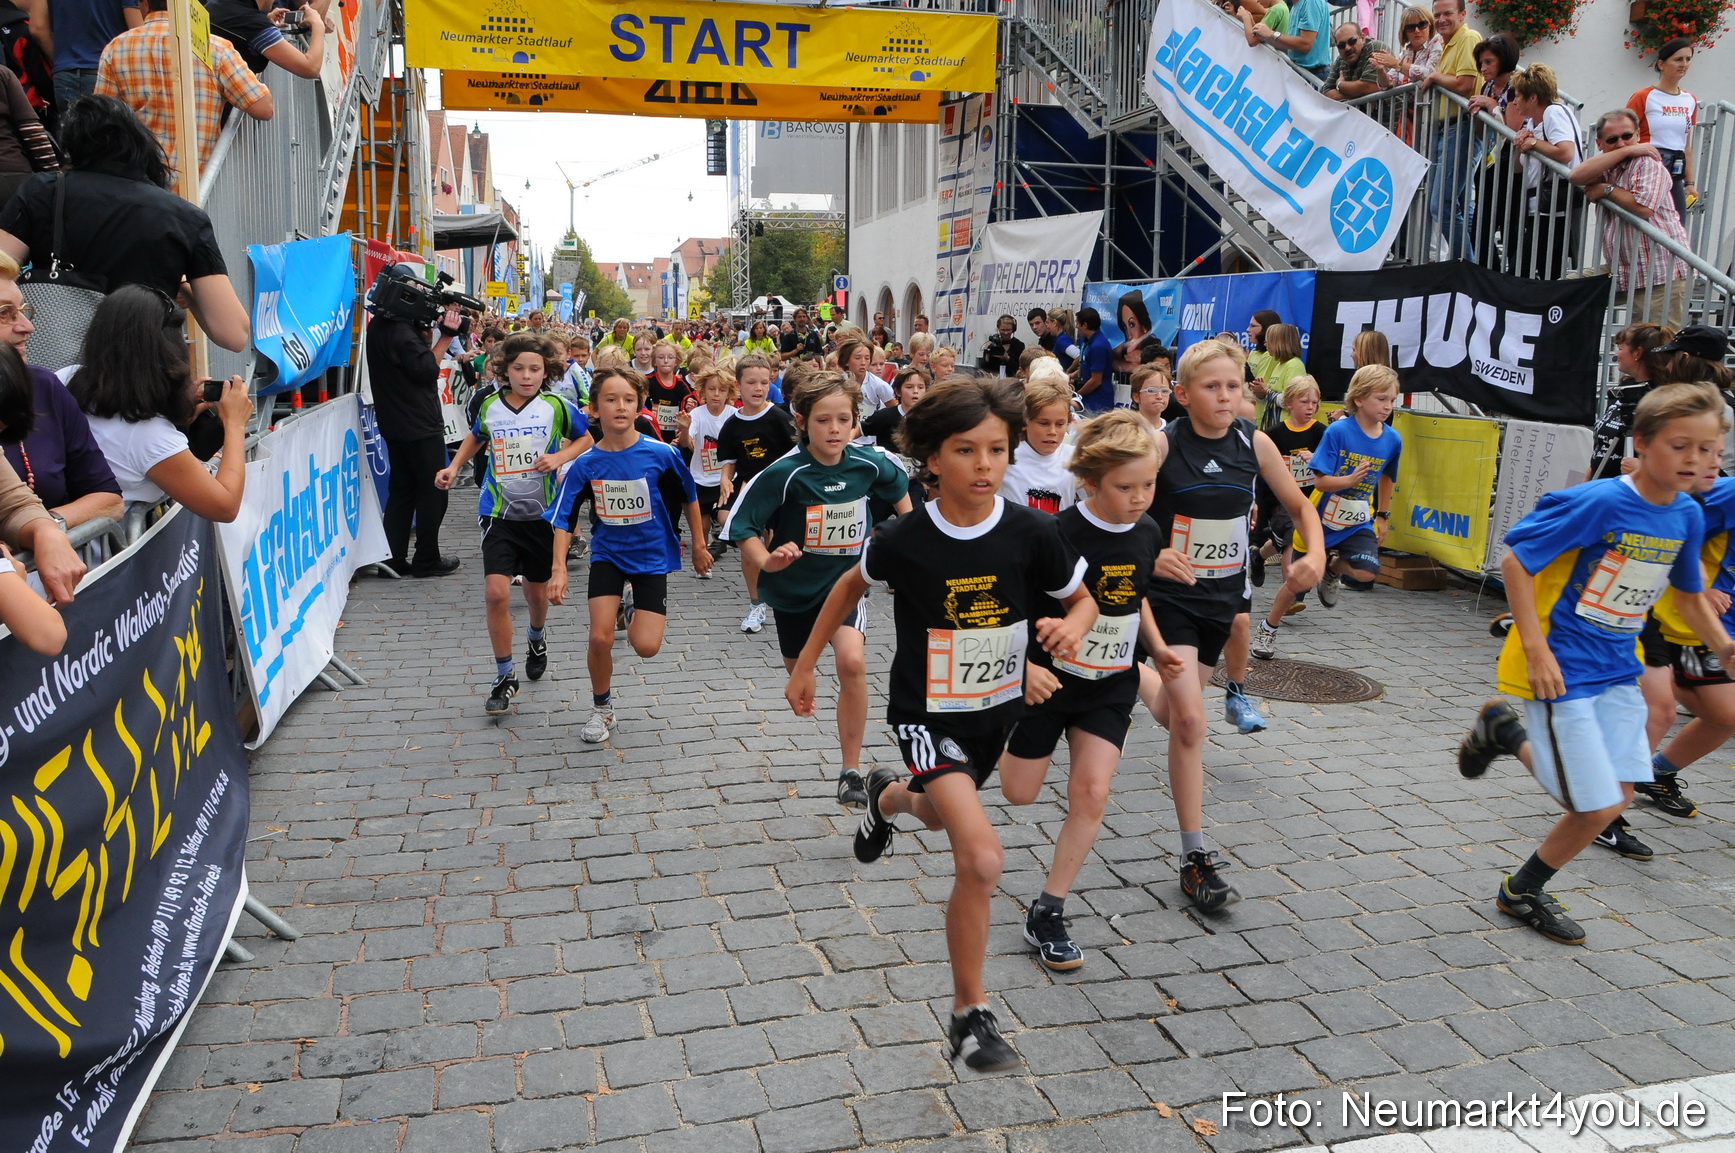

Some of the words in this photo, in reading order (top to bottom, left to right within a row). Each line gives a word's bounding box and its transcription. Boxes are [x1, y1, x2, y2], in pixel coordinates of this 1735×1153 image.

[440, 30, 514, 46] Neumarkter
[516, 34, 573, 49] Stadtlauf
[609, 13, 811, 69] START
[845, 51, 911, 66] Neumarkter
[913, 55, 966, 67] Stadtlauf
[467, 78, 529, 91] Neumarkter
[531, 80, 581, 92] Stadtlauf
[819, 91, 877, 103] Neumarkter
[878, 93, 922, 103] Stadtlauf
[1662, 106, 1689, 114] MERZ
[786, 121, 845, 135] BAROWS
[993, 259, 1080, 294] PFLEIDERER
[508, 300, 516, 309] A
[691, 307, 698, 316] A
[1181, 297, 1216, 331] maxi
[281, 332, 310, 371] dsl
[1335, 292, 1542, 395] THULE
[1474, 360, 1526, 386] SWEDEN
[505, 441, 520, 450] Luca
[507, 451, 539, 466] 7161
[605, 484, 628, 494] Daniel
[608, 497, 645, 511] 7030
[826, 507, 855, 520] Manuel
[1337, 509, 1366, 522] 7249
[1411, 505, 1470, 539] KANN
[826, 521, 863, 540] 7167
[1192, 542, 1239, 560] 7283
[946, 575, 998, 587] NEUMARKTER
[950, 583, 994, 593] STADTLAUF
[959, 607, 1010, 619] BAMBINILAUF
[1090, 622, 1120, 636] Lukas
[958, 634, 1022, 661] PAUL
[1085, 641, 1129, 660] 7130
[960, 654, 1018, 684] 7226
[14, 667, 57, 734] und
[53, 627, 114, 702] Nordic
[180, 834, 204, 857] Telefax
[169, 872, 189, 885] 93
[163, 886, 183, 901] 49
[141, 938, 165, 979] Telefon
[134, 980, 161, 1037] Nürnberg,
[71, 1081, 117, 1148] E-Mail:
